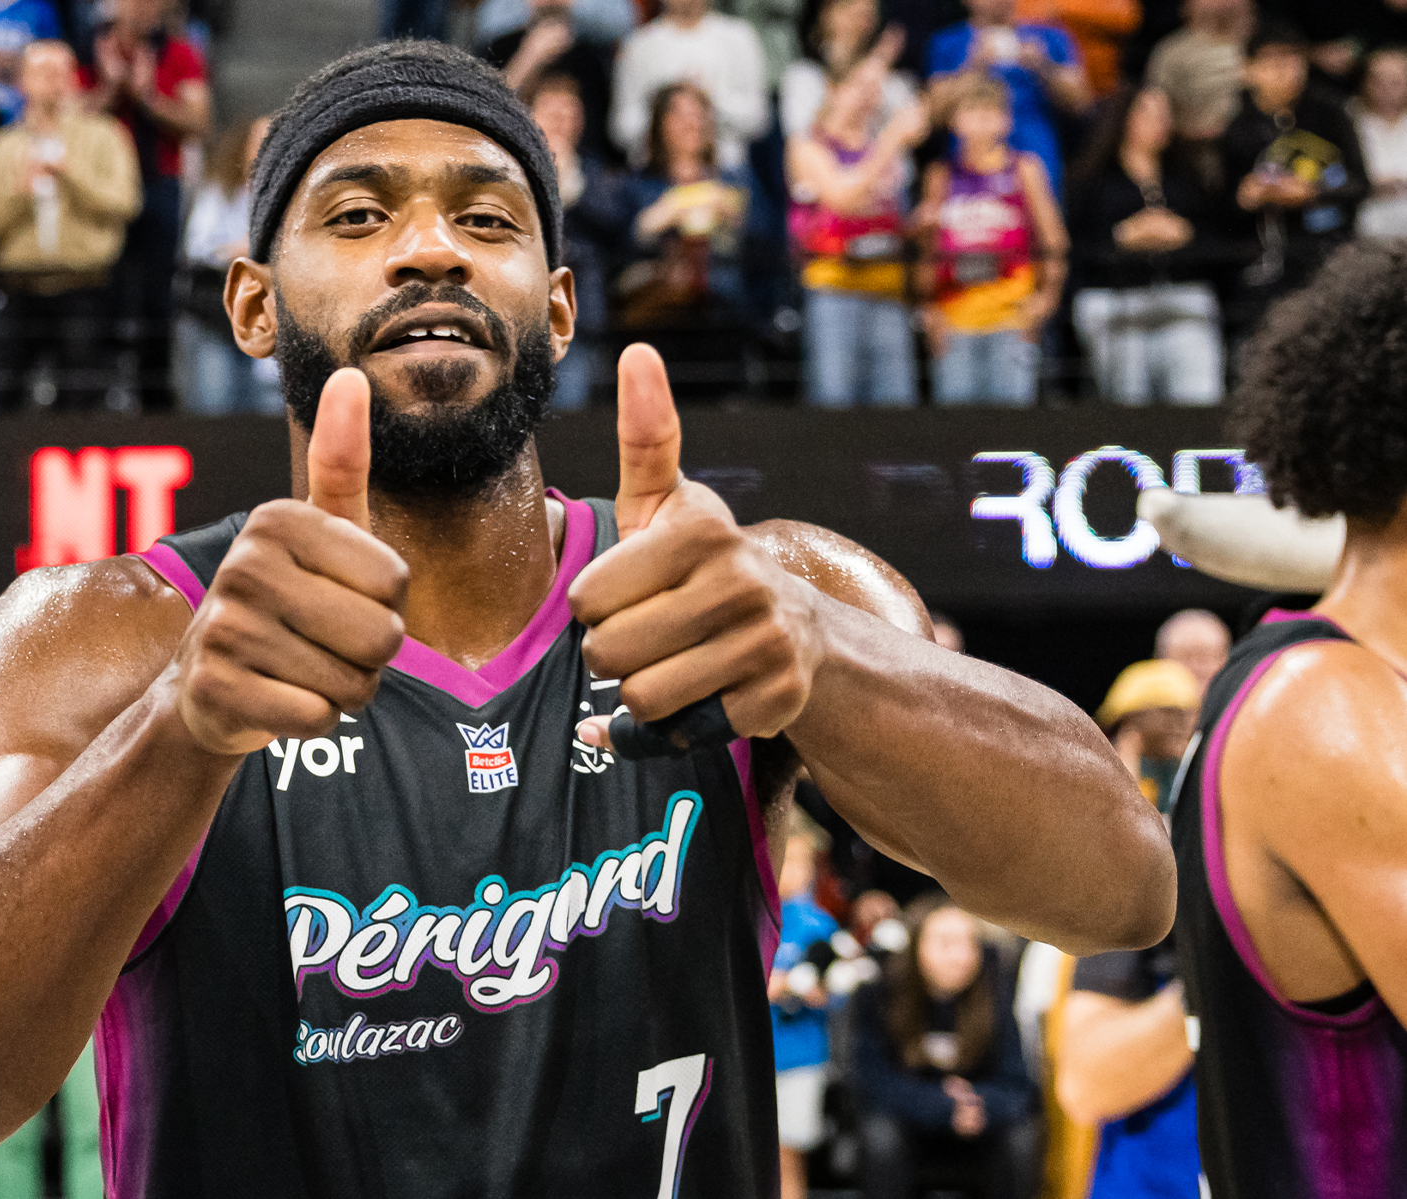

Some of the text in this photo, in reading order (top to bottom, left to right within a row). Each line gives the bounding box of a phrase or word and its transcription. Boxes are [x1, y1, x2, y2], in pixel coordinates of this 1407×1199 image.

[267, 735, 364, 792] yor
[472, 755, 507, 767] Betclic
[635, 1053, 712, 1199] 7
